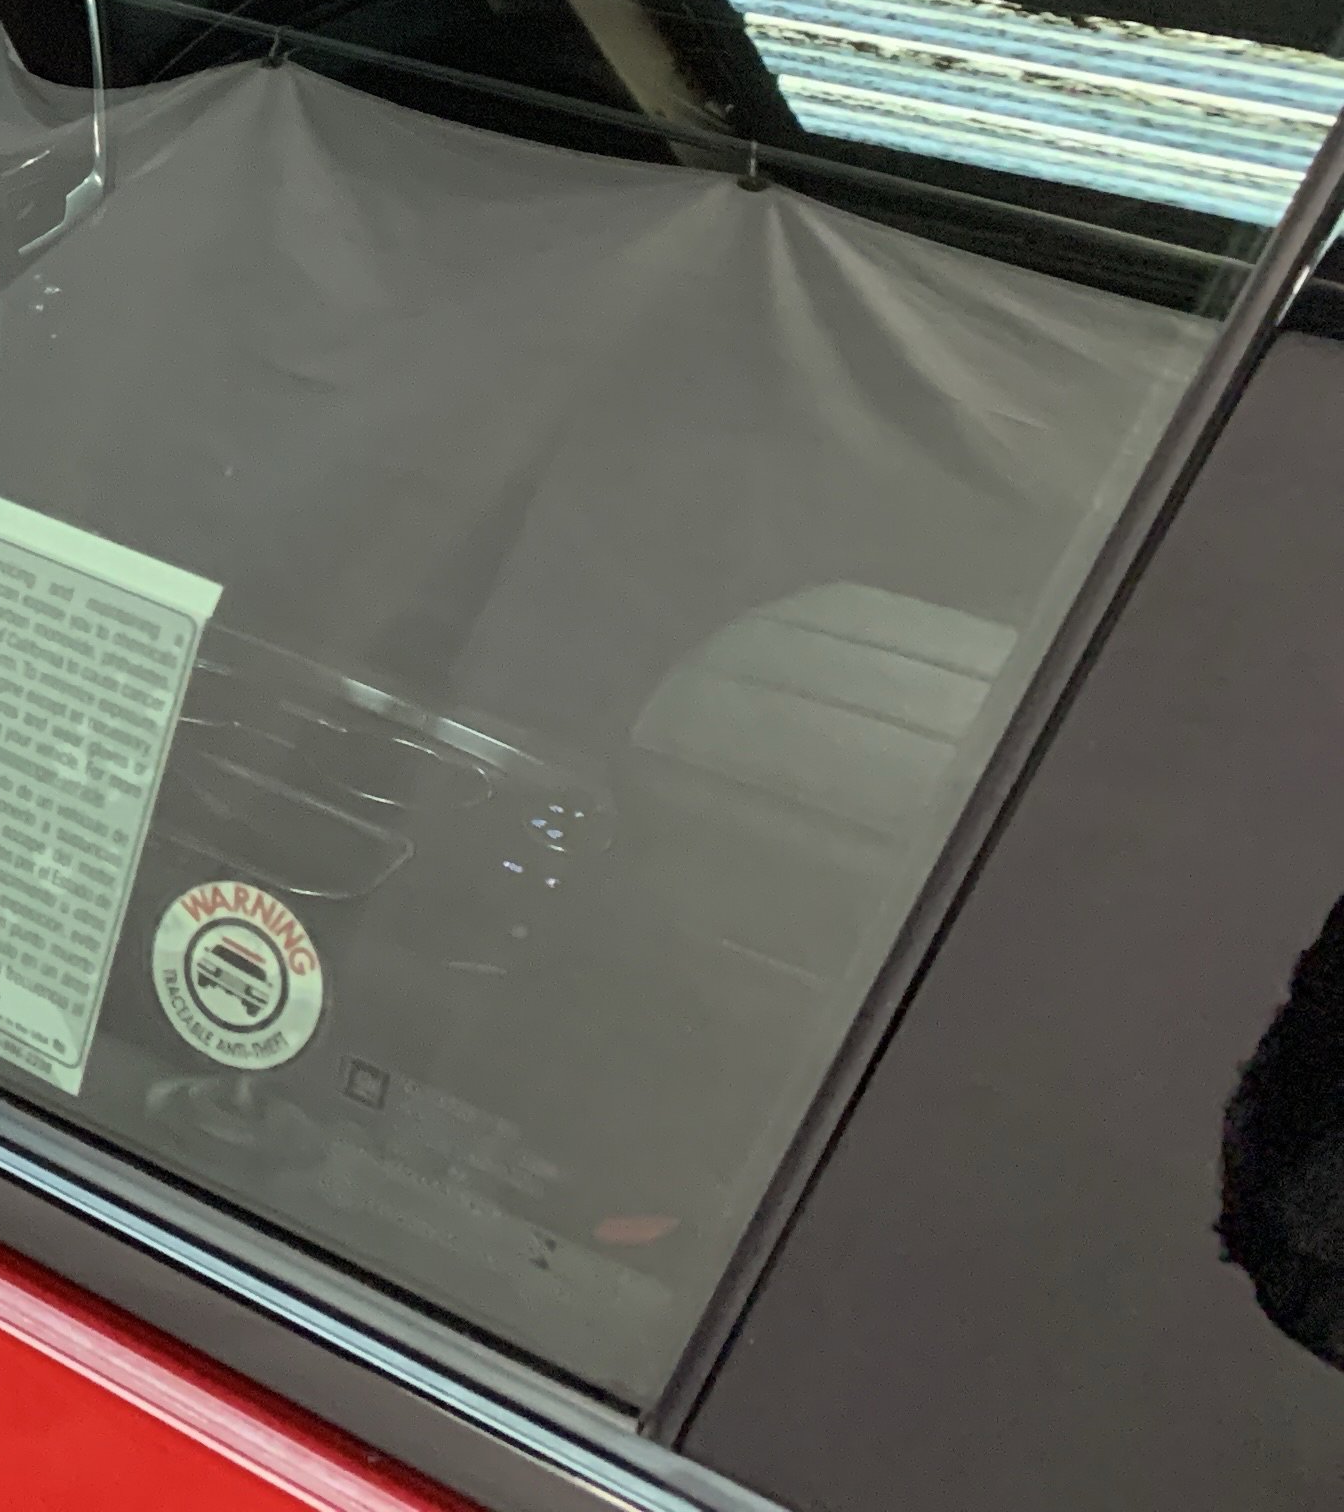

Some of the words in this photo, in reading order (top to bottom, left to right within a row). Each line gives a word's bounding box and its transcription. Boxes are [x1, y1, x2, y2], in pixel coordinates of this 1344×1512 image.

[182, 881, 317, 977] WARNING
[162, 968, 214, 1048] TRACEABLE
[216, 1030, 290, 1059] ANTI-THEFT
